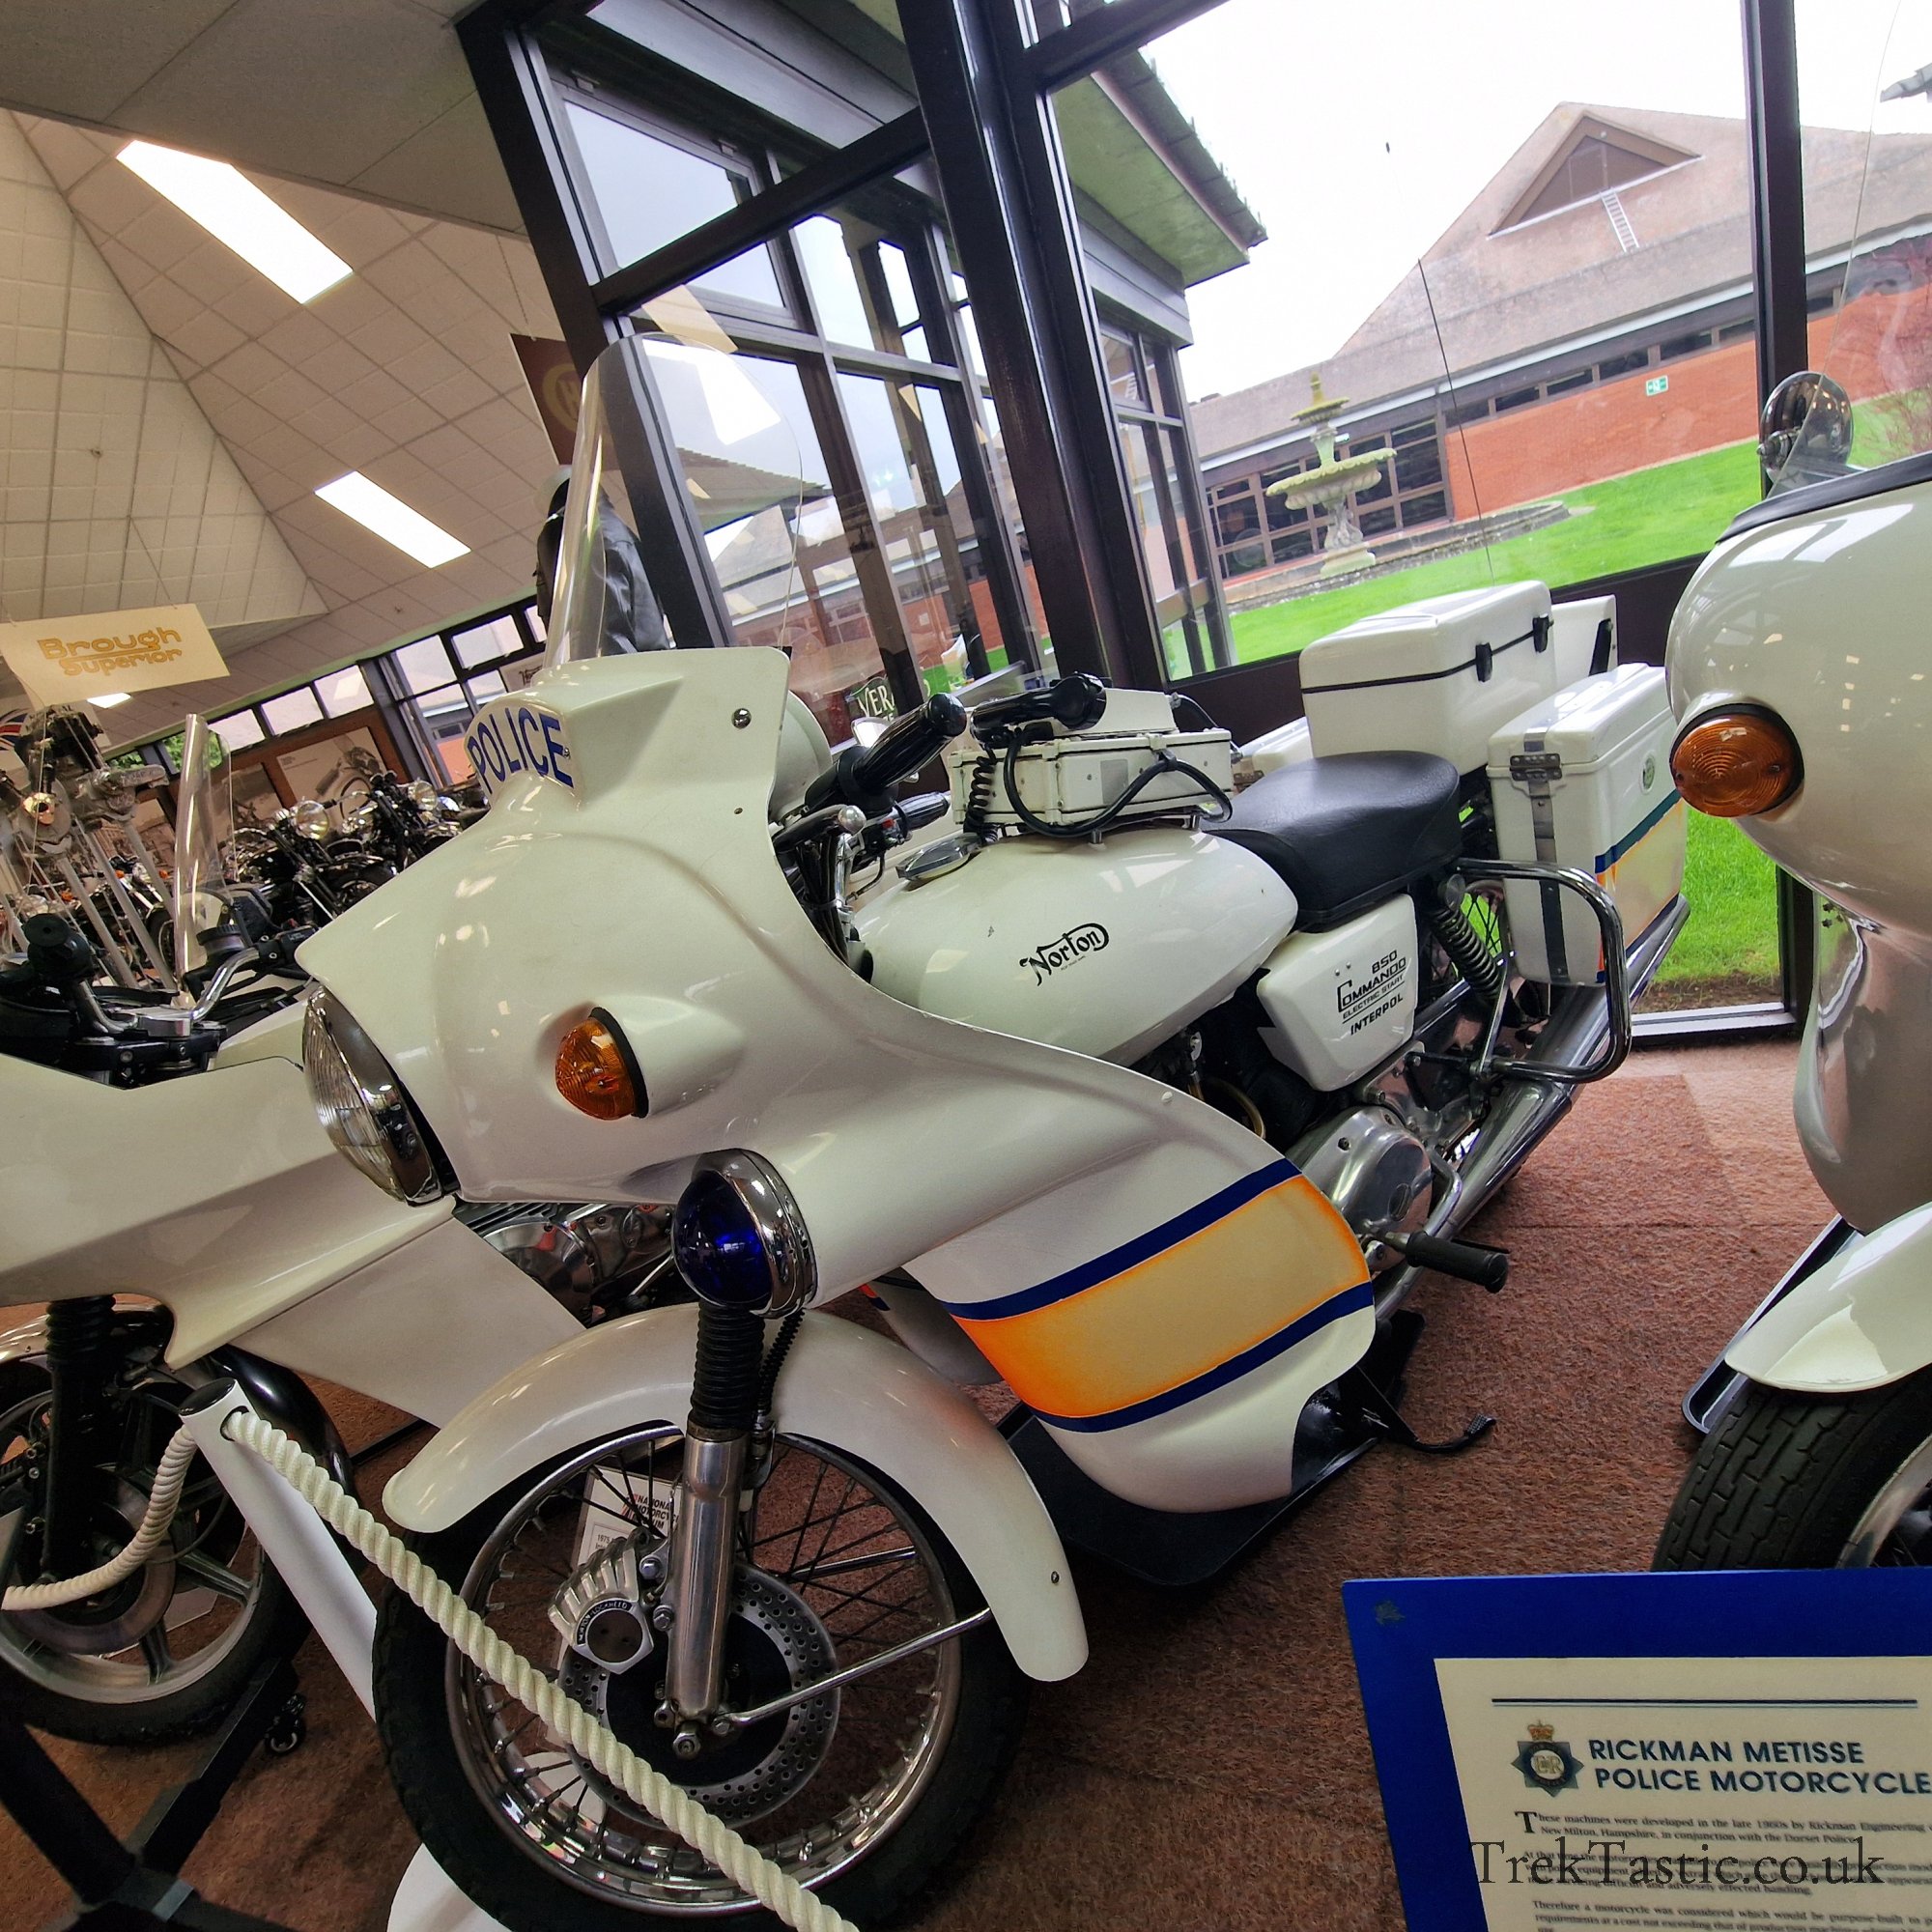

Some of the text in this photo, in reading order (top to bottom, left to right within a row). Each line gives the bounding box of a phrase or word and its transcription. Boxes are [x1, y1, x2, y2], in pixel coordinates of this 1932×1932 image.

[37, 627, 182, 660] Brough
[58, 648, 183, 676] Superior
[856, 685, 895, 718] VER
[467, 706, 574, 795] POLICE
[1019, 923, 1109, 986] Norton
[1372, 950, 1398, 974] 850
[1337, 956, 1406, 1013] COMMANDO
[1343, 974, 1404, 1019] ELECTRIC START
[1350, 993, 1404, 1036] INTERPOL
[1588, 1739, 1864, 1765] RICKMAN METISSE
[1595, 1767, 1932, 1795] POLICE MOTORCYCLE
[1514, 1811, 1560, 1833] These
[1564, 1815, 1610, 1824] machines
[1642, 1816, 1693, 1828] developed
[1712, 1818, 1728, 1827] the
[1732, 1819, 1751, 1829] late
[1791, 1820, 1804, 1831] by
[1808, 1821, 1855, 1831] Rickman
[1541, 1826, 1561, 1834] New
[1674, 1832, 1736, 1841] conjunction
[1784, 1833, 1820, 1842] Dorset
[1532, 1900, 1580, 1910] Therefore
[1594, 1904, 1650, 1915] motorcycle
[1677, 1908, 1734, 1918] considered
[1738, 1910, 1770, 1918] which
[1774, 1911, 1807, 1920] would
